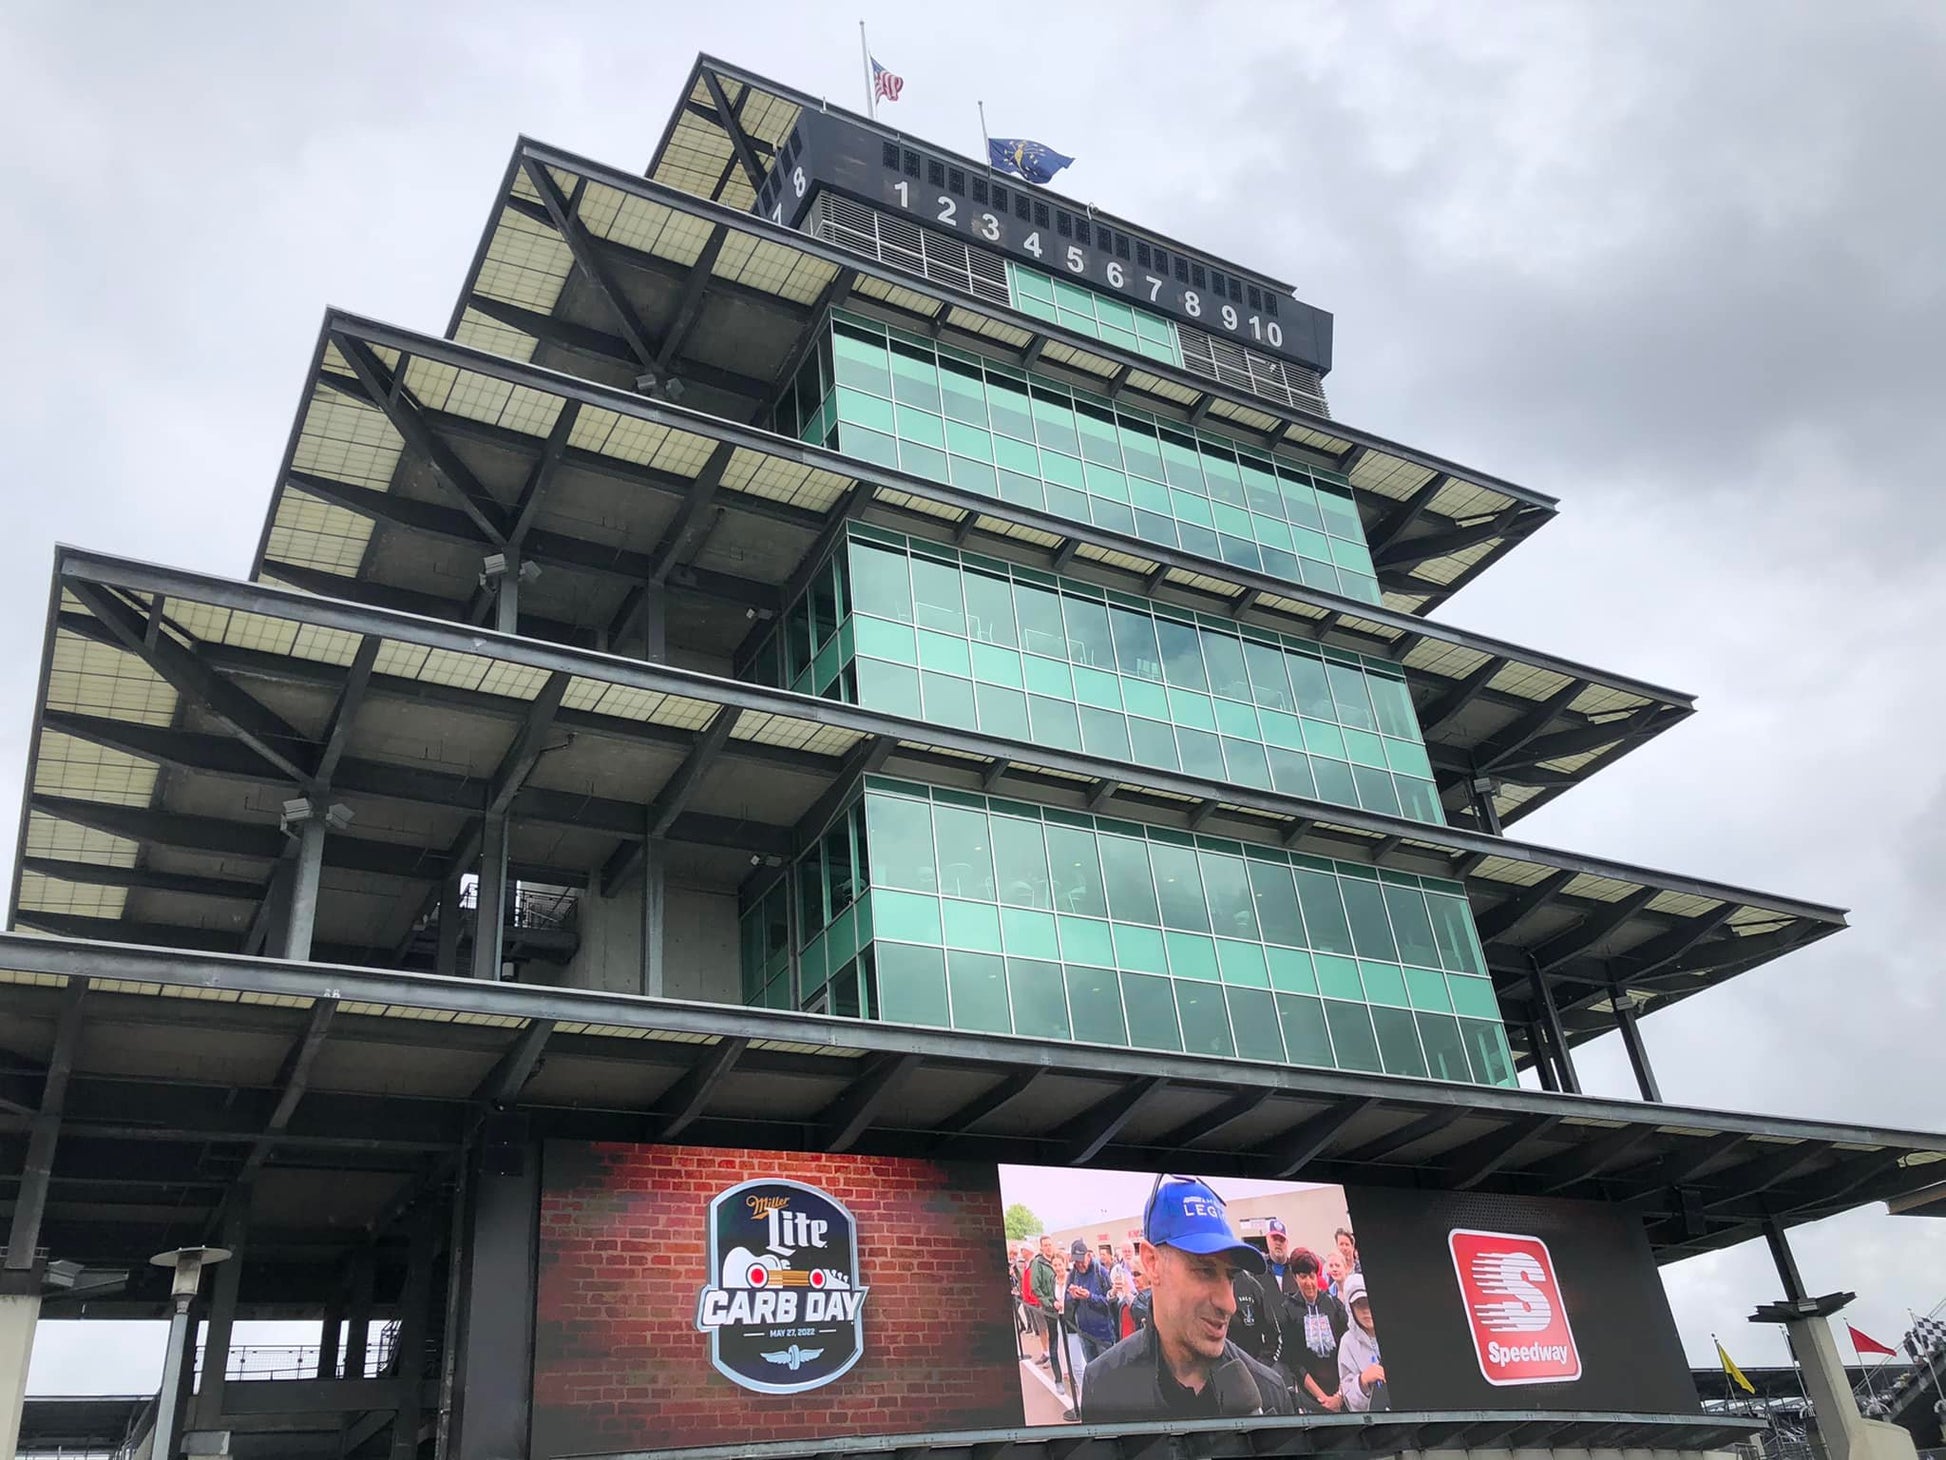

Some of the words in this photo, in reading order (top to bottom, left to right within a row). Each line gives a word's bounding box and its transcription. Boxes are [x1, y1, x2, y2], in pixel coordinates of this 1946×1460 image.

[793, 166, 806, 198] 8
[894, 181, 909, 208] 1
[937, 196, 957, 226] 2
[982, 213, 1000, 241] 3
[1023, 232, 1043, 258] 4
[1066, 245, 1085, 273] 5
[1106, 262, 1124, 288] 6
[1146, 275, 1163, 302] 7
[1184, 290, 1201, 317] 8
[1221, 305, 1238, 330] 9
[1249, 315, 1283, 347] 10
[746, 1195, 791, 1220] Miller
[766, 1207, 828, 1257] Lite
[702, 1290, 798, 1326] CARB
[805, 1290, 862, 1321] DAY
[769, 1329, 786, 1338] MAY
[786, 1328, 797, 1338] 27,
[797, 1327, 816, 1336] 2022
[1487, 1341, 1568, 1367] Speedway
